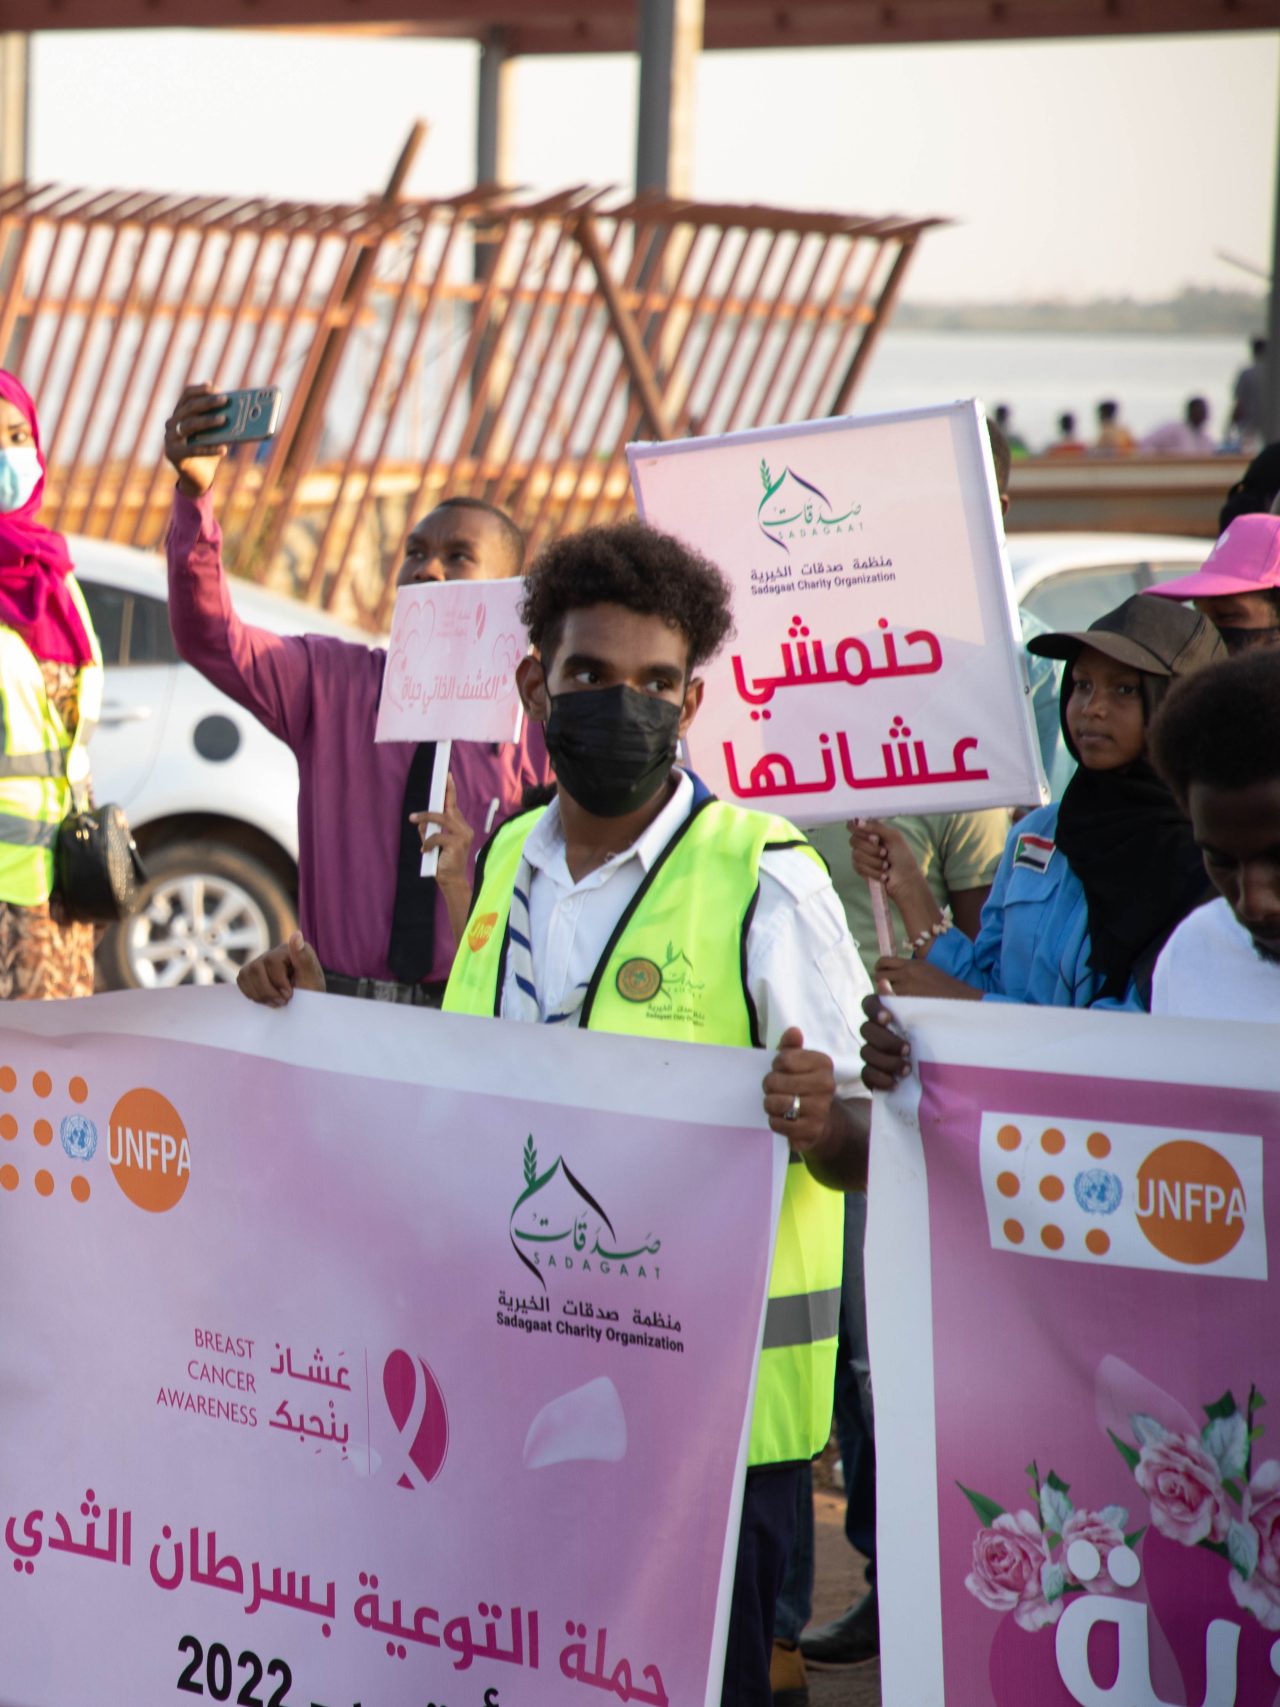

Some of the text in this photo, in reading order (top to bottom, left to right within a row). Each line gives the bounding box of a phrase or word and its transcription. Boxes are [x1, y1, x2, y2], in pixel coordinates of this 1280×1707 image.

[750, 556, 893, 584] منظمة صدقات الخيرية
[751, 572, 896, 595] Sadagaat Charity Organization
[731, 615, 943, 721] حنمشي
[722, 715, 990, 798] عشانها
[106, 1125, 191, 1177] UNFPA
[1136, 1176, 1247, 1227] UNFPA
[533, 1251, 662, 1280] SADAGAAT
[496, 1311, 685, 1353] Sadagaat Charity Organization
[498, 1290, 682, 1332] منظمة صدقات الخيرية
[194, 1328, 255, 1360] BREAST
[187, 1360, 257, 1394] CANCER
[156, 1387, 258, 1427] AWARENESS
[5, 1488, 669, 1707] حملة التوعية بسرطان الثدي
[176, 1634, 293, 1707] 2022
